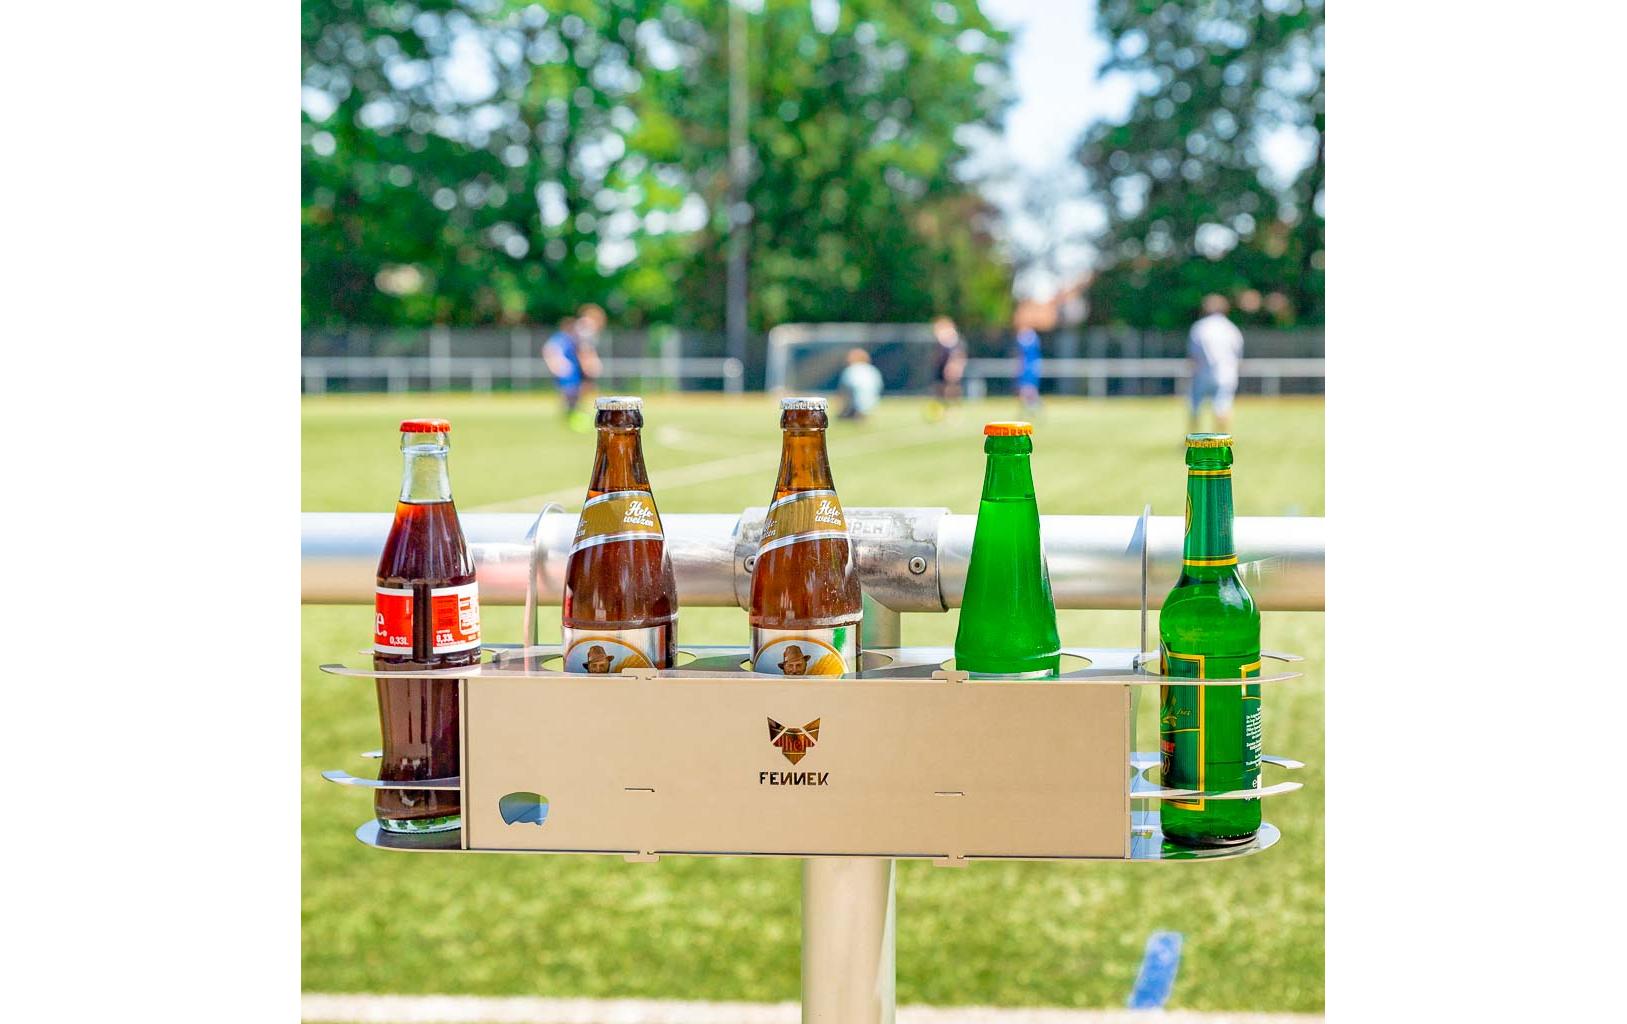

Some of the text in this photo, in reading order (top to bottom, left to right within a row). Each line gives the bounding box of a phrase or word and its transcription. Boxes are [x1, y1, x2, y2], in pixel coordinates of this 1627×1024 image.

[623, 515, 654, 528] weizen
[815, 514, 842, 527] weizen
[759, 771, 830, 786] FENNEK
